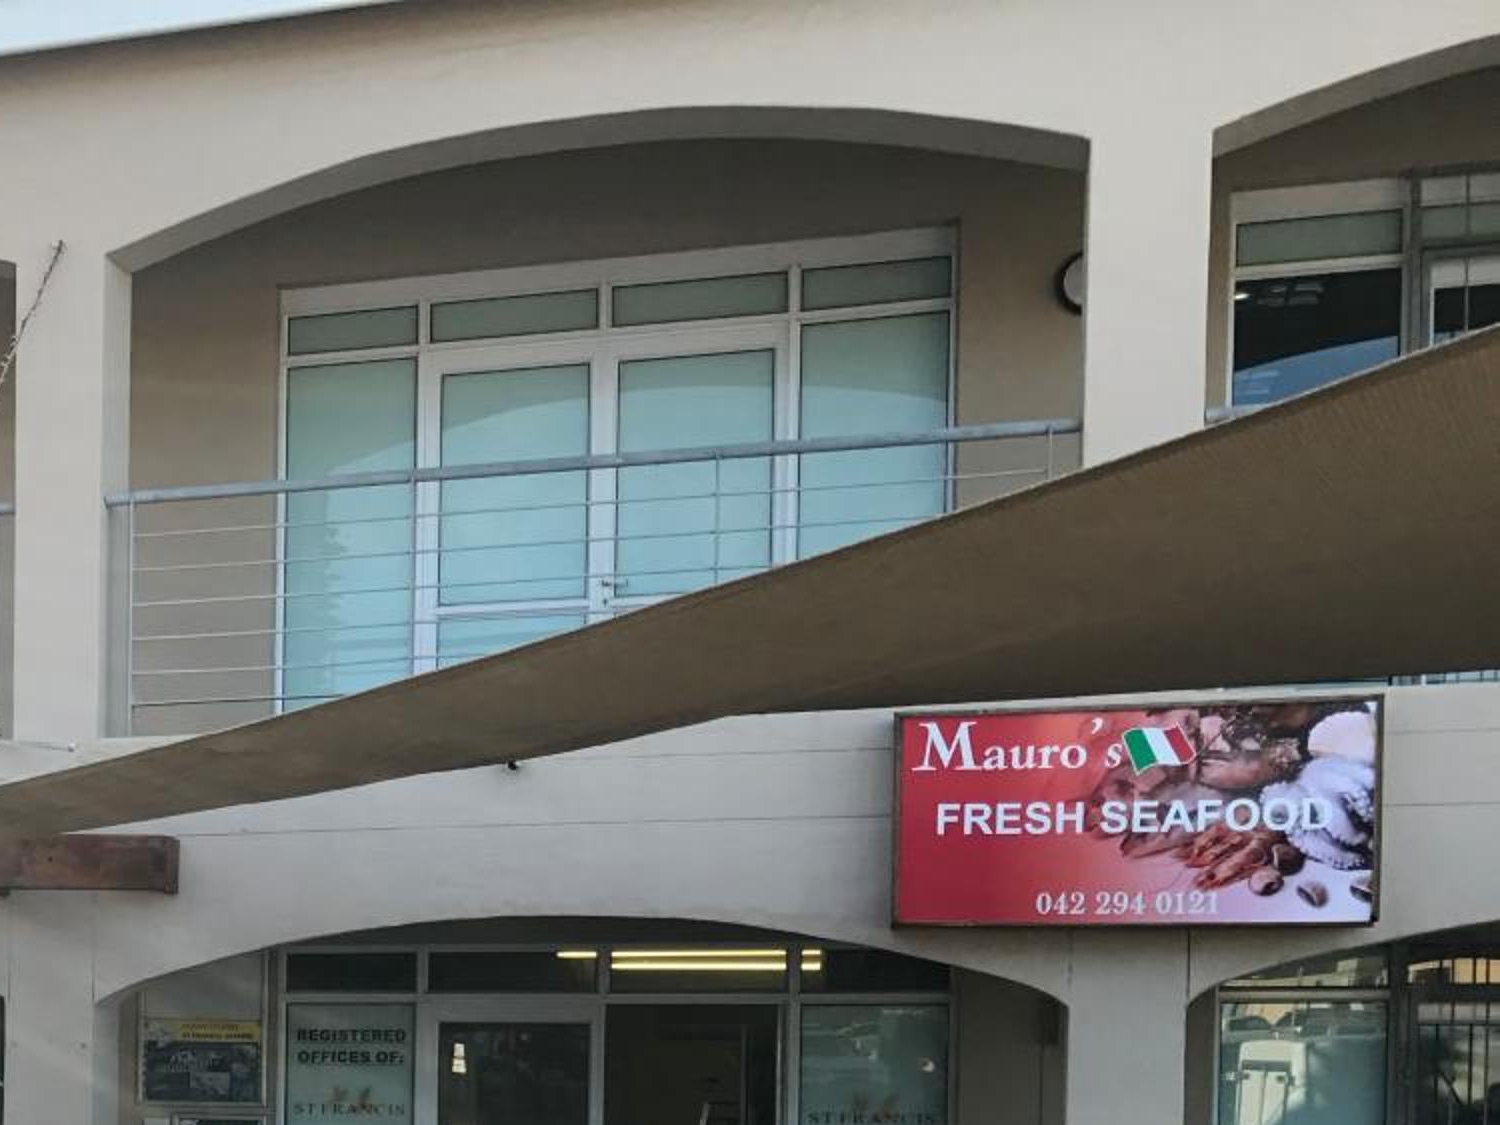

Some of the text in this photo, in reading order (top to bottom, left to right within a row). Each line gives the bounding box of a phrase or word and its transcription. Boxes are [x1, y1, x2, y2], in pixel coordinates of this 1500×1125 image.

[912, 716, 1123, 772] Mauro's
[937, 798, 1332, 835] FRESH SEAFOOD
[1035, 891, 1219, 915] 042 294 0121
[297, 1028, 406, 1043] REGISTERED
[297, 1050, 372, 1065] OFFICES
